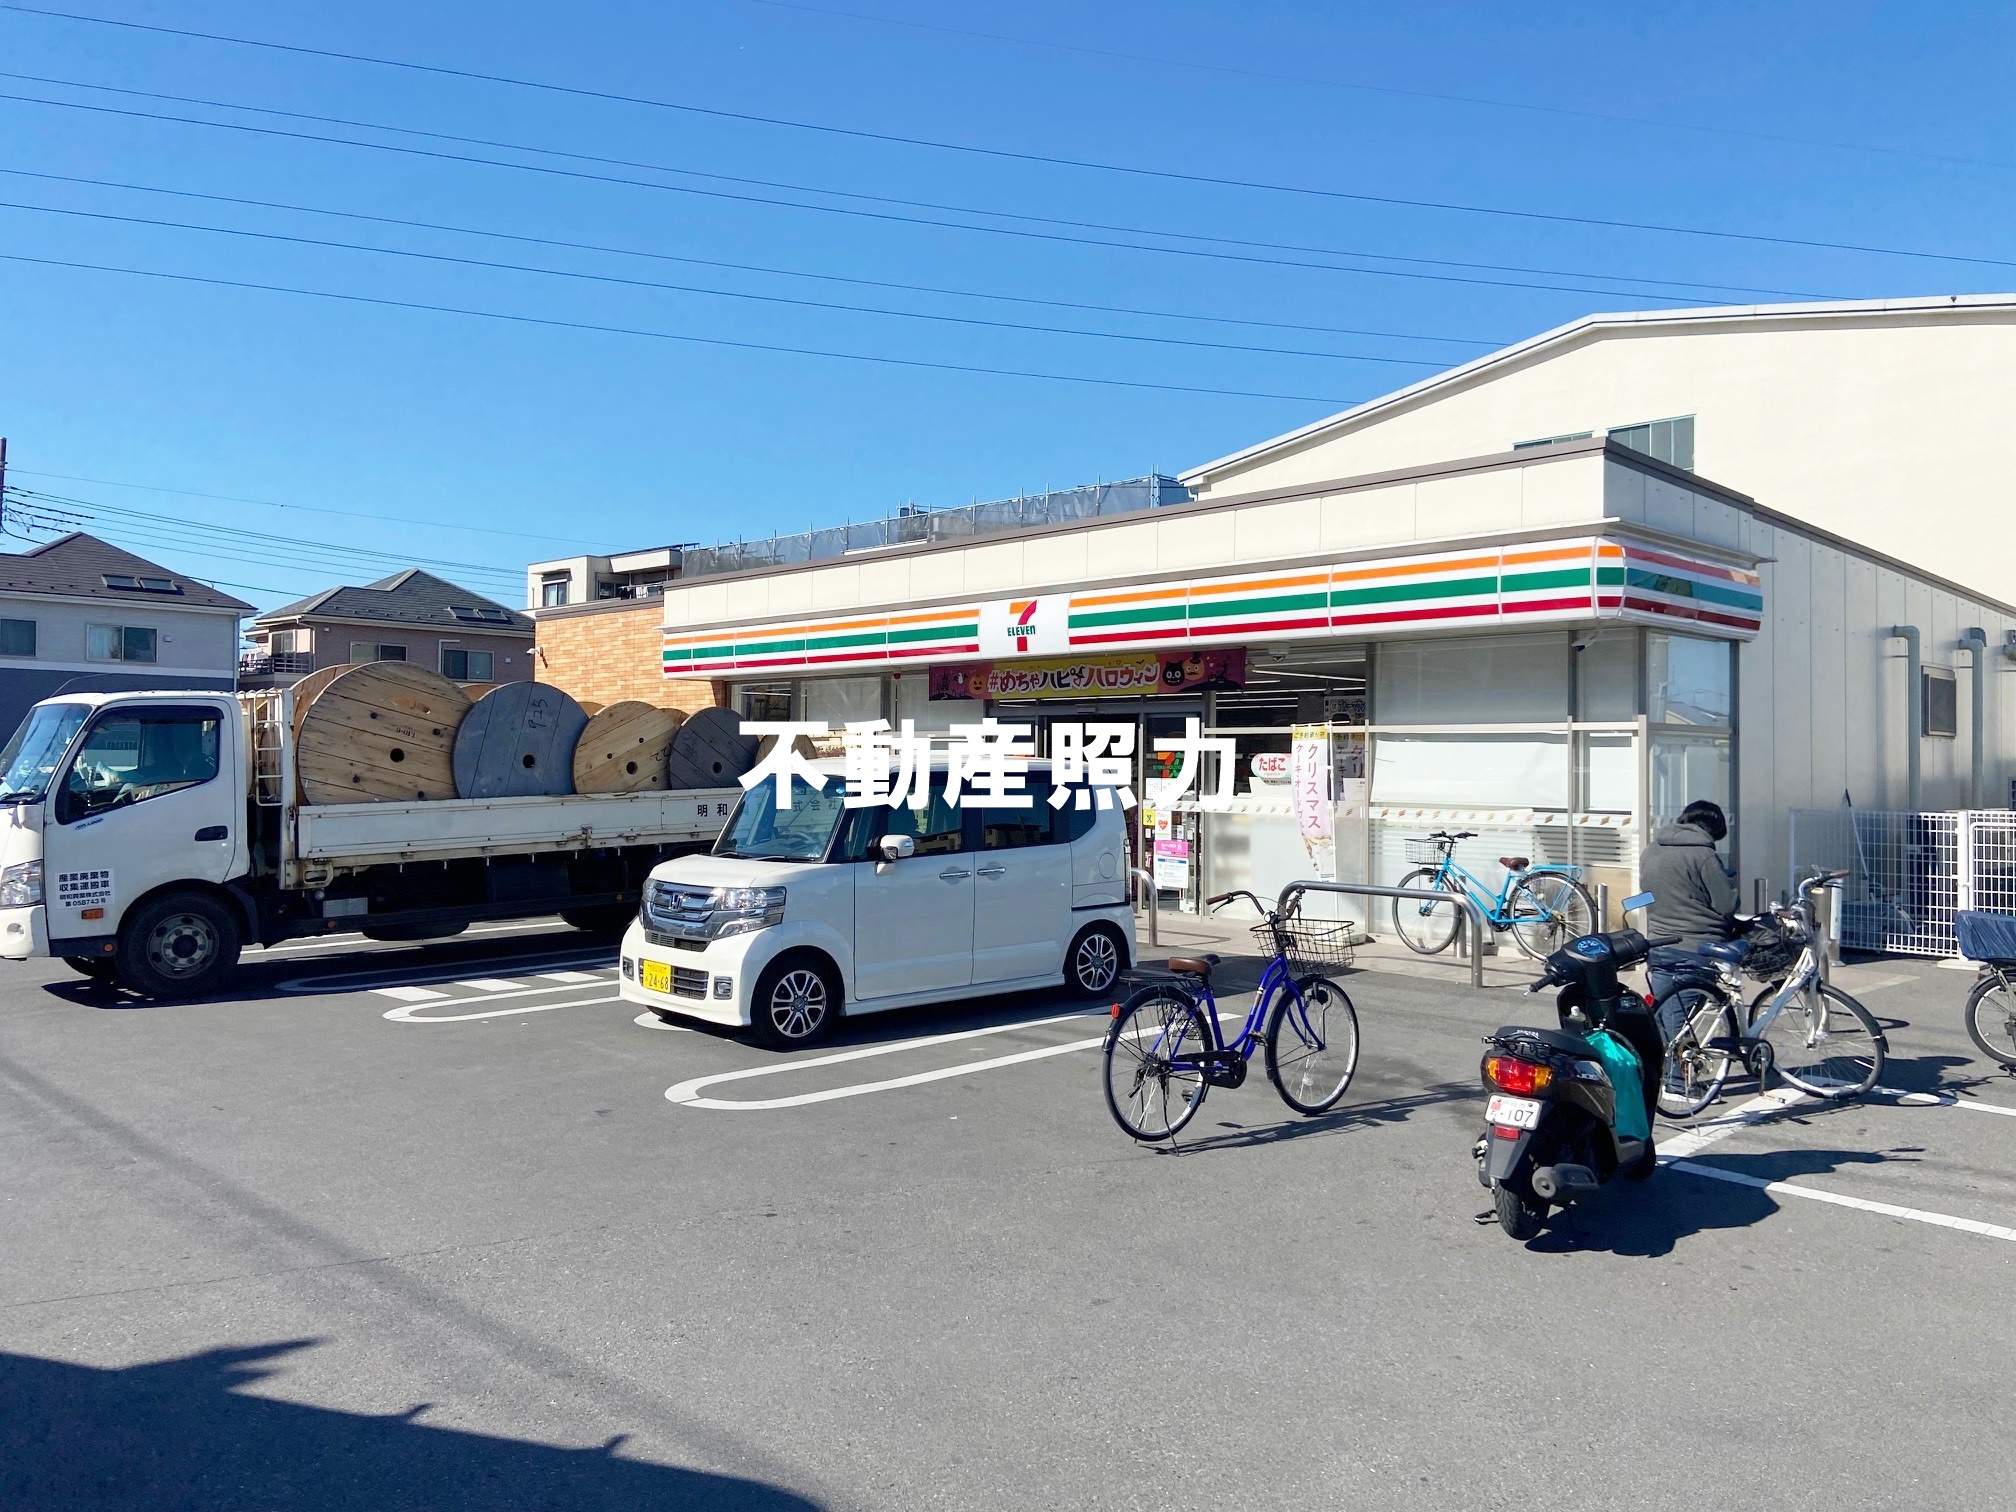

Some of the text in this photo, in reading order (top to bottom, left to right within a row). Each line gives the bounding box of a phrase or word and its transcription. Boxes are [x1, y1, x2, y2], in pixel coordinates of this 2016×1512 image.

[1259, 757, 1286, 771] たばこ
[1306, 744, 1320, 828] クリスマス
[697, 804, 728, 817] 明和
[59, 871, 109, 882] 産業廃棄物
[59, 880, 109, 891] 収集運搬車
